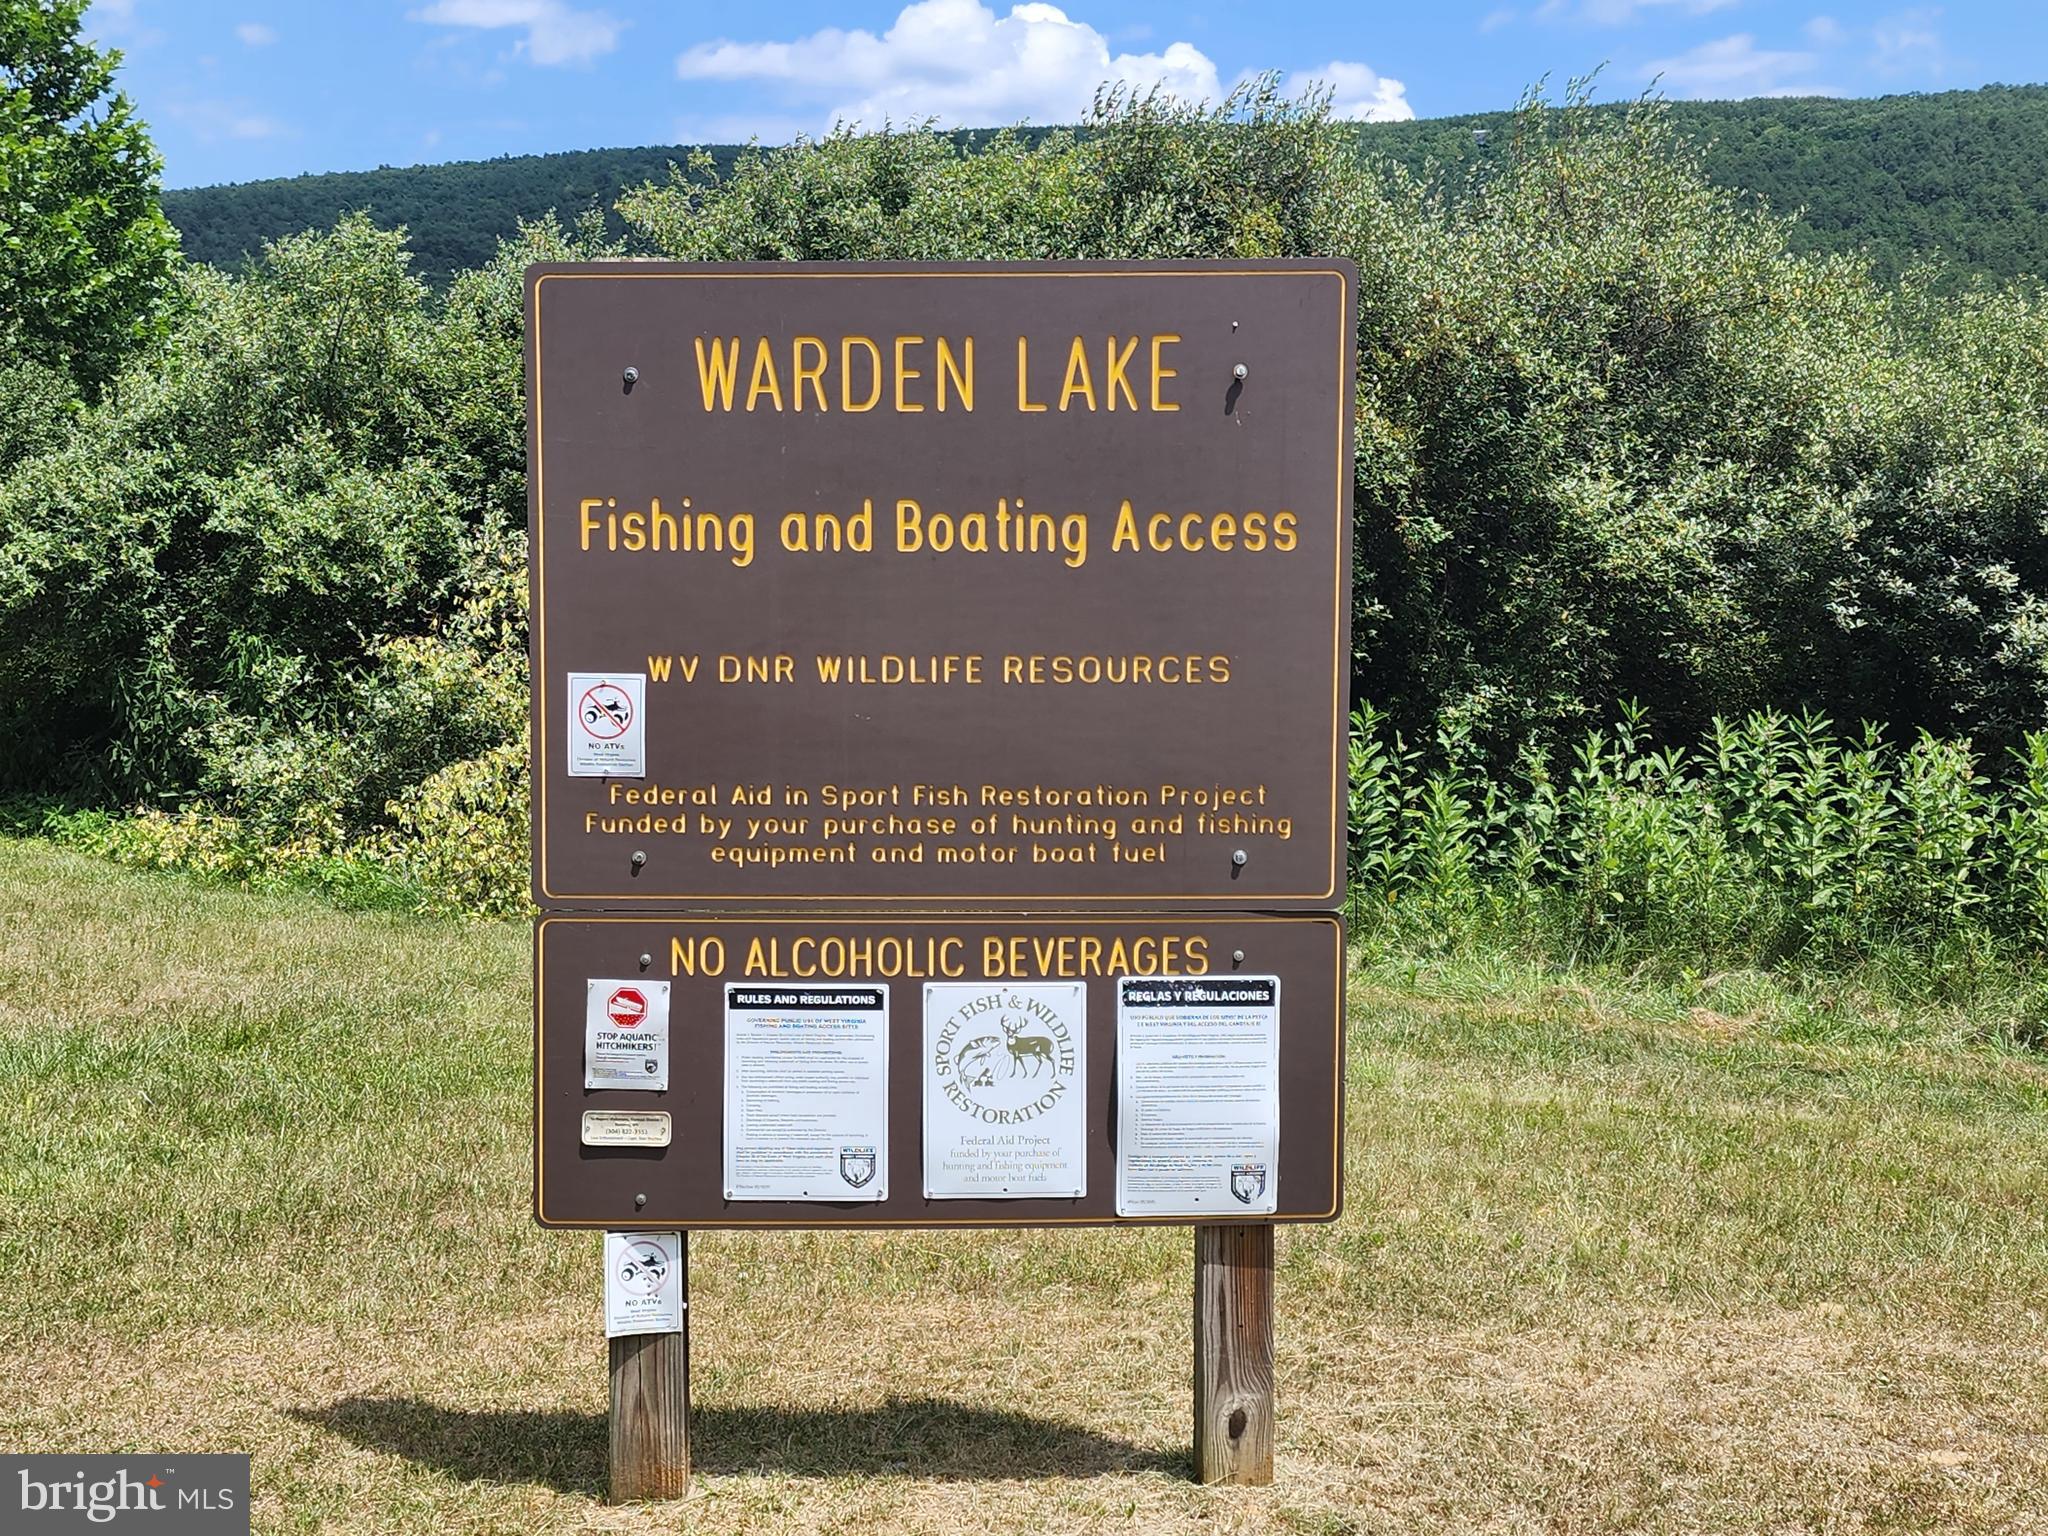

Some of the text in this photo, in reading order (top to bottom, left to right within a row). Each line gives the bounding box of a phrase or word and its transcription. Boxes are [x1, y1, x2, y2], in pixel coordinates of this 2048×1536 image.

[693, 333, 1182, 413] WARDEN LAKE
[579, 497, 1300, 568] Fishing and Boating Access
[646, 654, 1232, 684] WV DNR WILDLIFE RESOURCES
[609, 783, 1267, 812] Federal Aid in Sport Fish Restoration Project
[585, 812, 1292, 840] Funded by your purchase of hunting and fishing
[710, 842, 1166, 868] equipment and motor boat fuel
[671, 935, 1210, 978] NO ALCOHOLIC BEVERAGES
[737, 994, 876, 1005] RULES AND REGULATIONS
[1129, 990, 1270, 1002] REGLAS Y REGULACIONES
[597, 1032, 657, 1041] STOP AQUATIC
[935, 994, 1075, 1077] SPORT FISH & WILDLIFE
[596, 1042, 657, 1051] HITCHHIKERS!
[943, 1080, 1067, 1125] RESTORATION
[960, 1135, 1050, 1147] Federal Aid Project
[950, 1147, 1062, 1160] funded by your purchase of
[942, 1161, 1067, 1172] hunting and fishing equipment
[963, 1172, 1047, 1182] and motor boat fuels
[625, 1298, 662, 1307] NO ATVs
